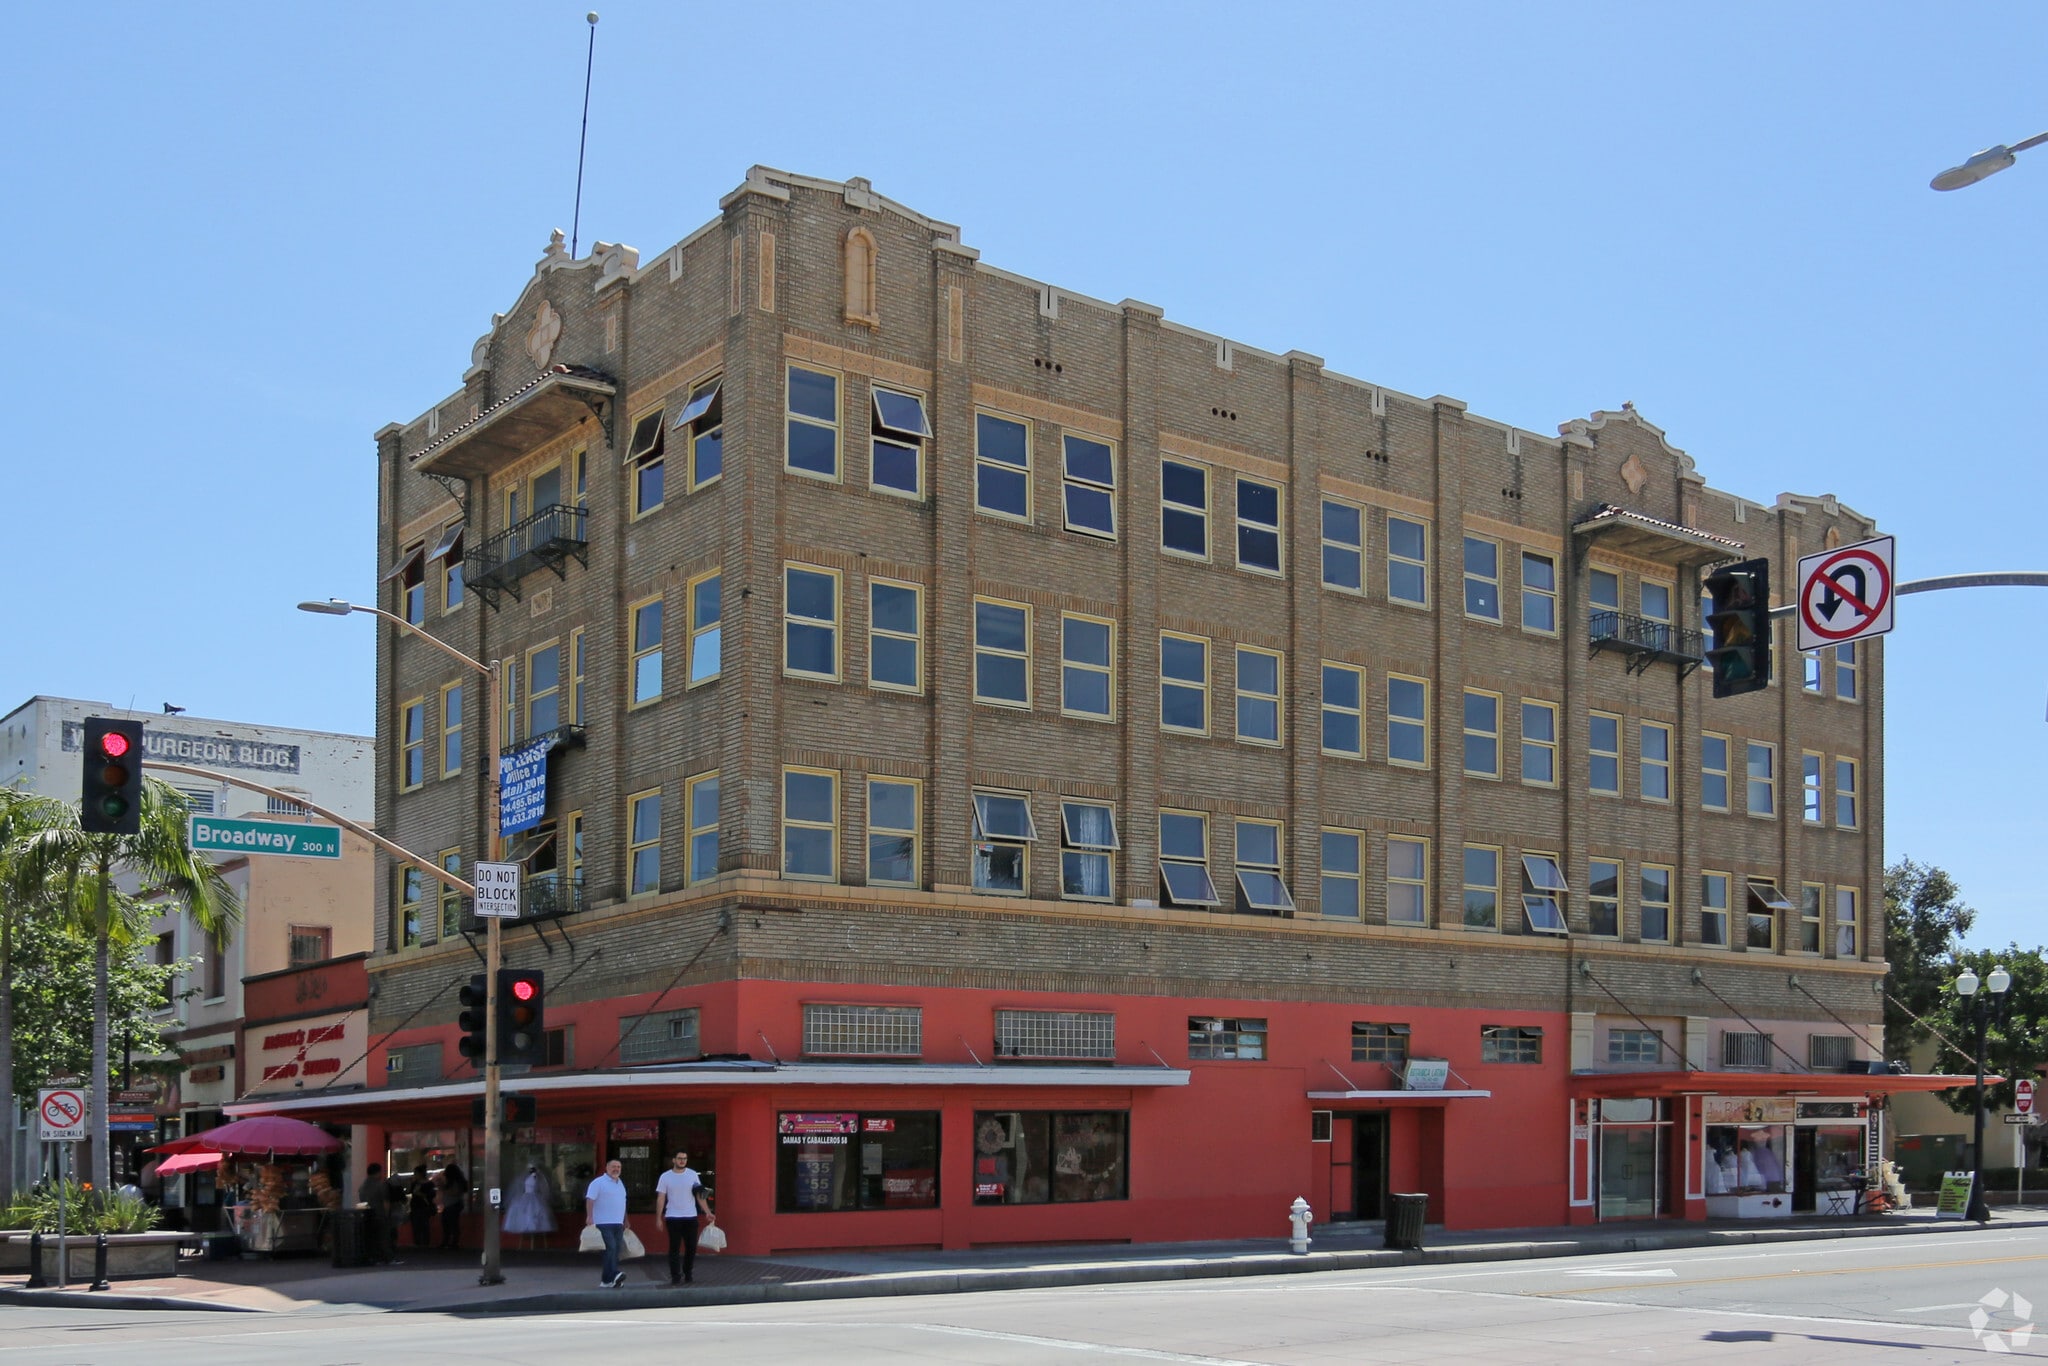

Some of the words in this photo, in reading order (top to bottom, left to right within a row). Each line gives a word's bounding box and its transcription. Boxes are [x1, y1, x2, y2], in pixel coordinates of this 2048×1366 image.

[143, 734, 232, 761] URGEON
[239, 748, 295, 768] BLDG.
[196, 824, 297, 852] Broadway
[302, 841, 323, 852] 300
[327, 843, 335, 853] N
[478, 869, 492, 882] DO
[496, 870, 516, 883] NOT
[478, 886, 516, 901] BLOCK
[478, 901, 517, 912] INTERSECTION
[42, 1130, 51, 1138] ON
[53, 1130, 82, 1138] SIDEWALK
[782, 1136, 801, 1144] DAMAS
[802, 1136, 806, 1144] Y
[807, 1136, 840, 1144] CABALLEROS
